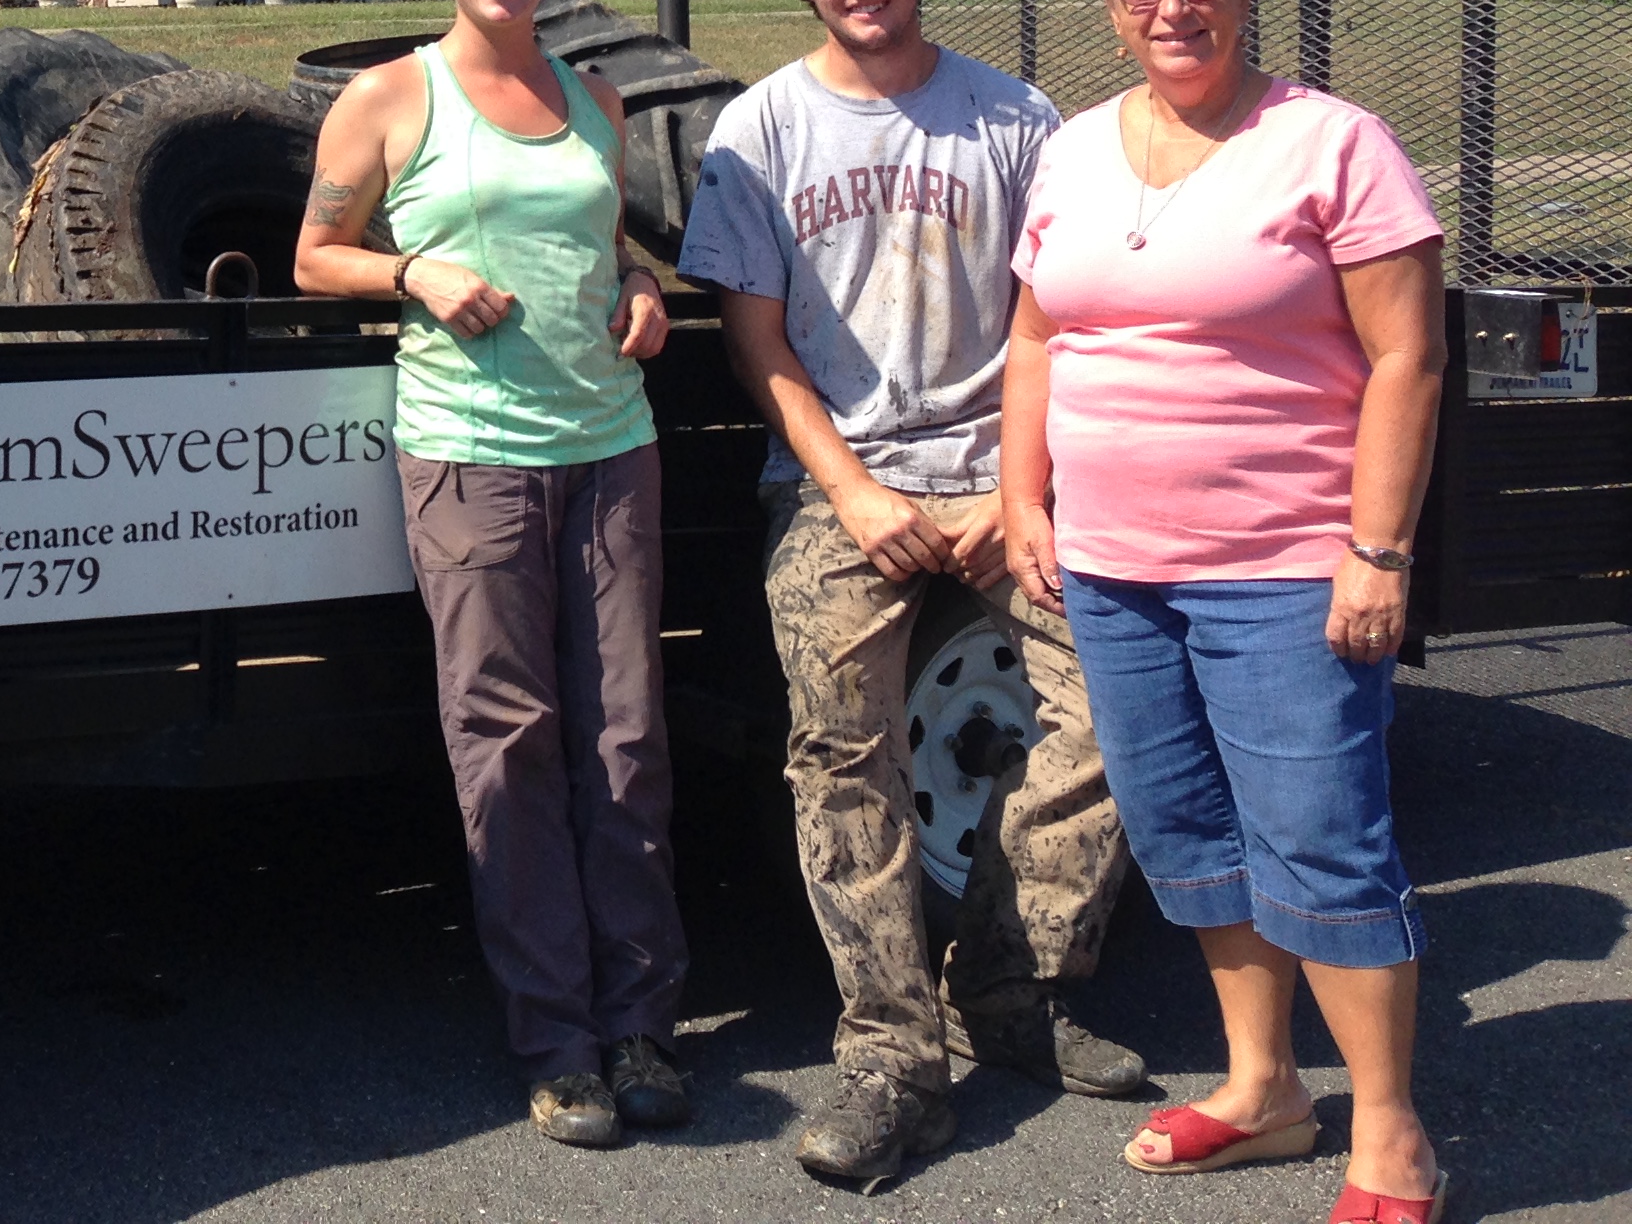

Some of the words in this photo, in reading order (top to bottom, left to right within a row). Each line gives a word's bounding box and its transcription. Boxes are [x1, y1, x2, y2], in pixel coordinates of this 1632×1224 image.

[792, 164, 969, 247] HARVARD
[122, 511, 180, 545] and
[191, 503, 359, 540] Restoration
